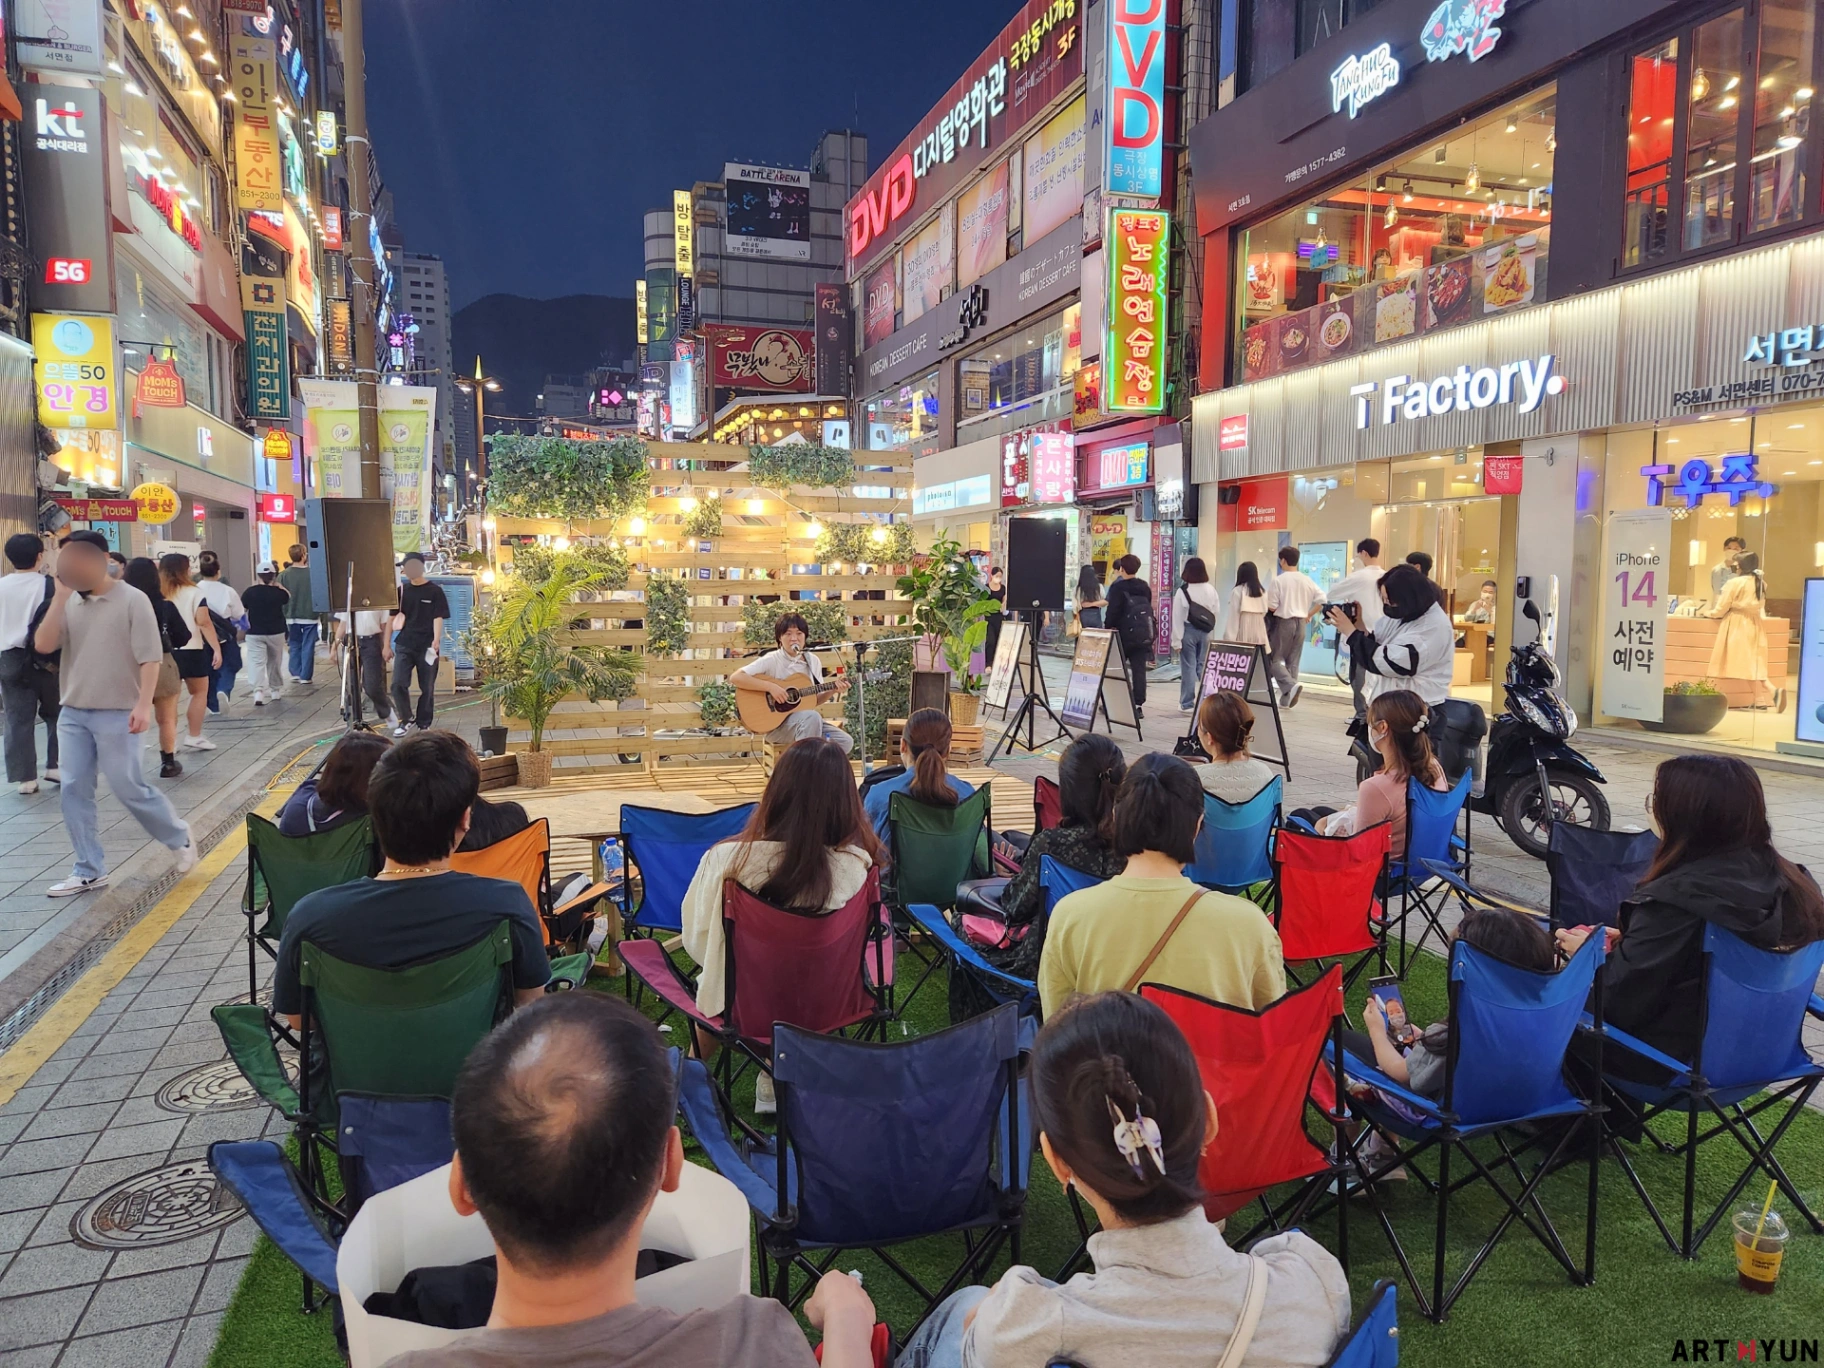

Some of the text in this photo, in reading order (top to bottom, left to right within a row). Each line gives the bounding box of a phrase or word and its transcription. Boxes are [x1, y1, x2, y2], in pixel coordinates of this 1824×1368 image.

[1057, 25, 1076, 60] 3F
[45, 52, 74, 63] 서면점
[36, 98, 85, 138] kt
[913, 55, 1007, 179] 디지털영화관
[36, 138, 88, 154] 공식대리점
[243, 113, 274, 190] 부동산
[1124, 149, 1147, 164] 극장
[741, 169, 773, 181] BATTLE
[774, 173, 801, 184] ARENA
[1113, 163, 1158, 180] 동시상영
[1284, 146, 1346, 184] 가맹문의 1577-4382
[240, 190, 280, 201] 851-2300
[1127, 180, 1144, 193] 3F
[852, 153, 917, 258] DVD
[677, 203, 691, 263] 방탈출
[54, 260, 86, 282] 5G
[1039, 267, 1062, 290] DESSERT
[1062, 259, 1076, 277] CAFE
[680, 278, 691, 305] LOUNGE
[869, 282, 889, 315] DVD
[1122, 235, 1156, 393] 노래연습장
[254, 315, 281, 414] 전치과의원
[869, 353, 889, 377] KOREAN
[889, 343, 913, 367] DESSERT
[912, 333, 928, 354] CAFE
[43, 363, 106, 382] 으뜸50
[43, 383, 110, 414] 안경
[143, 386, 178, 398] TOUCH
[1673, 388, 1713, 407] PS&M
[1717, 376, 1776, 400] 서면센터
[1045, 438, 1062, 497] 폰사랑
[1101, 449, 1129, 486] DVD
[136, 498, 174, 513] 부동산
[141, 487, 164, 498] 이안
[104, 505, 132, 517] TOUCH
[1248, 506, 1257, 515] SK
[1093, 522, 1123, 535] DVD
[1616, 553, 1660, 566] iPhone
[1615, 571, 1657, 608] 14
[1614, 620, 1654, 645] 사전
[1207, 651, 1251, 674] 당신만의
[1613, 647, 1654, 674] 예약
[1203, 668, 1245, 691] iPhone
